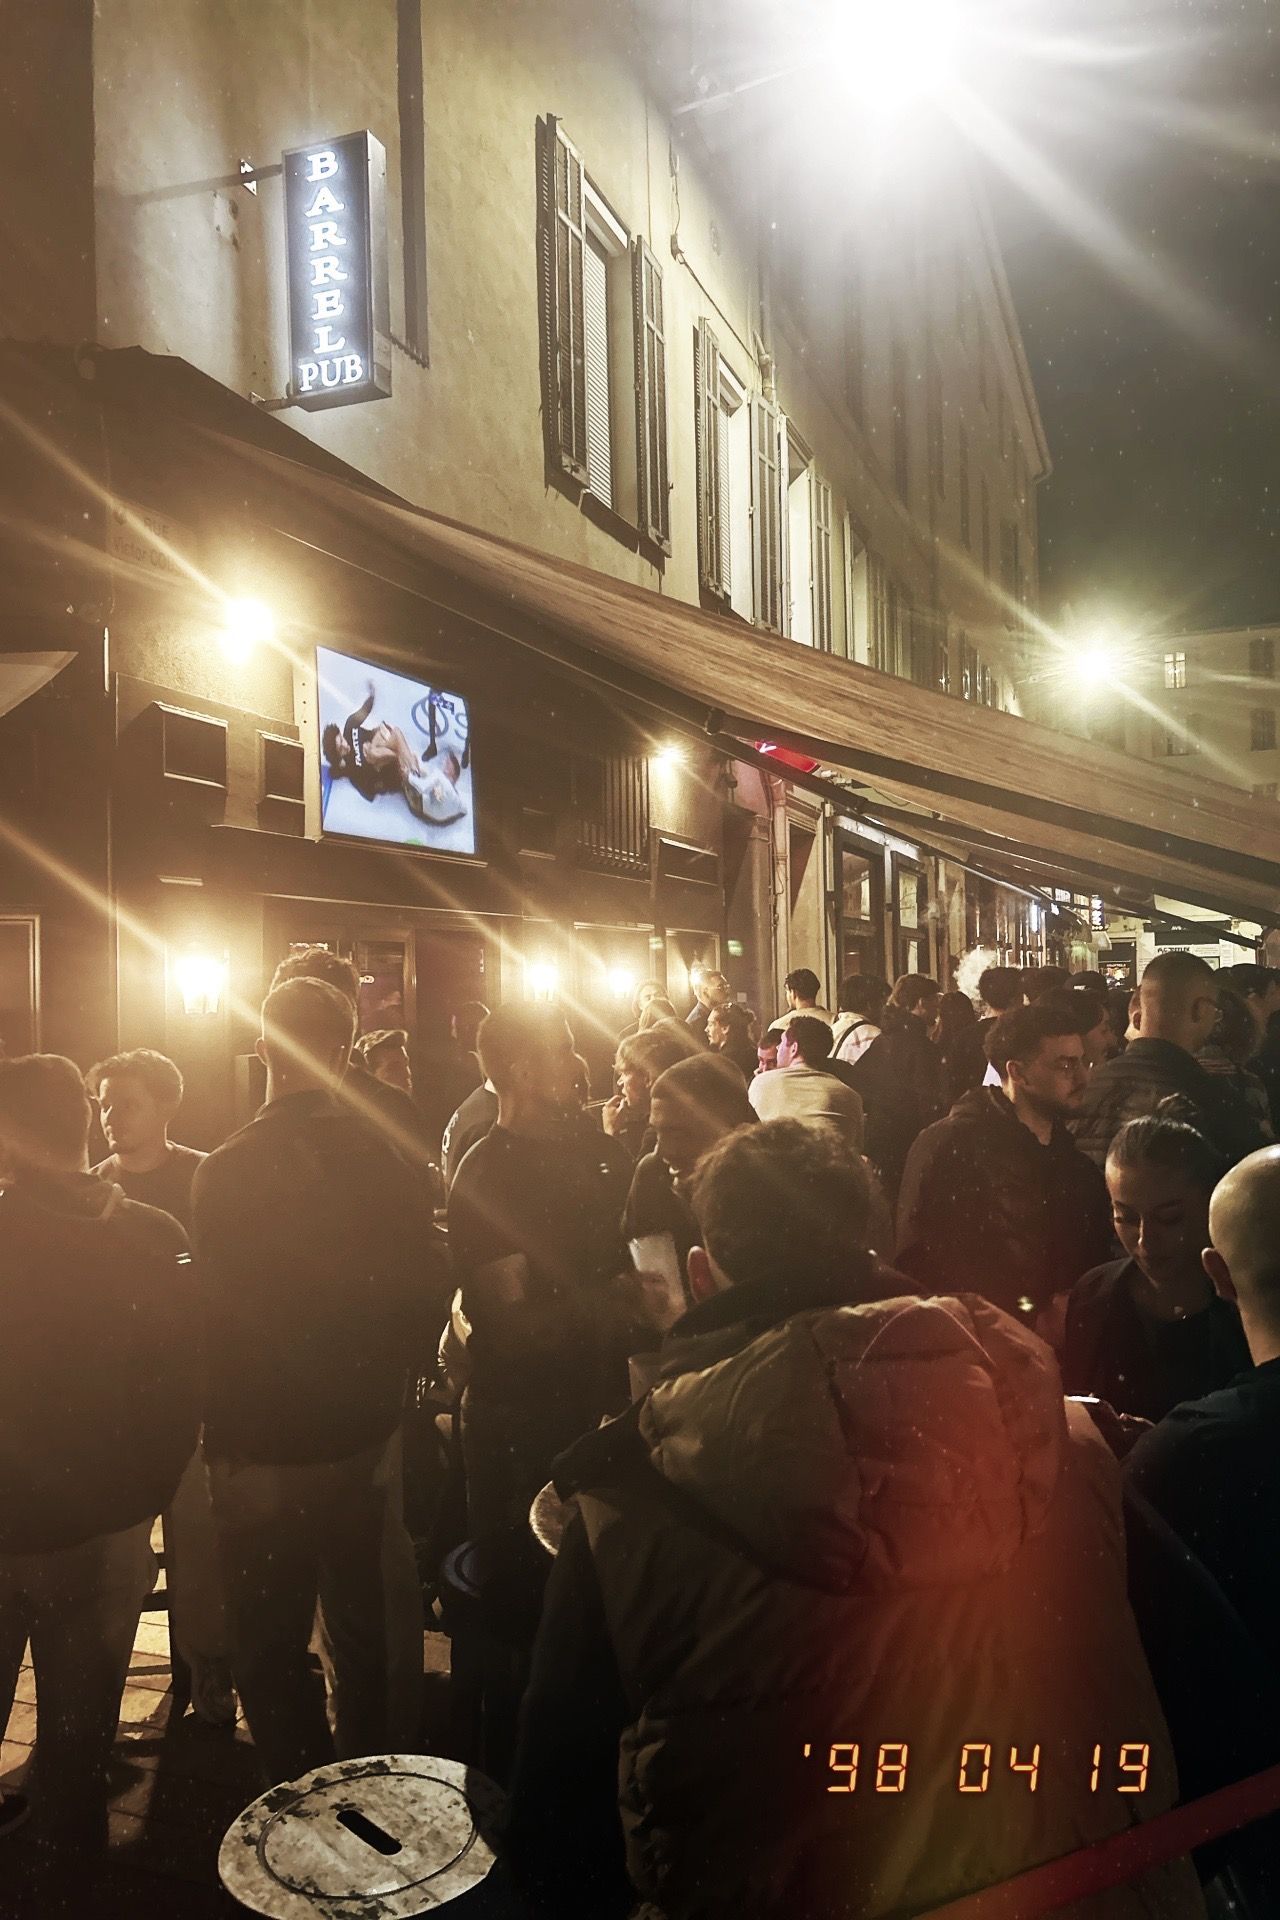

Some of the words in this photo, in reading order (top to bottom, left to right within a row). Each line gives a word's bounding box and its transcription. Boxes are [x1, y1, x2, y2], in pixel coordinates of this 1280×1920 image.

[304, 150, 348, 354] BARREL
[299, 353, 364, 392] PUB
[143, 516, 170, 541] RUE
